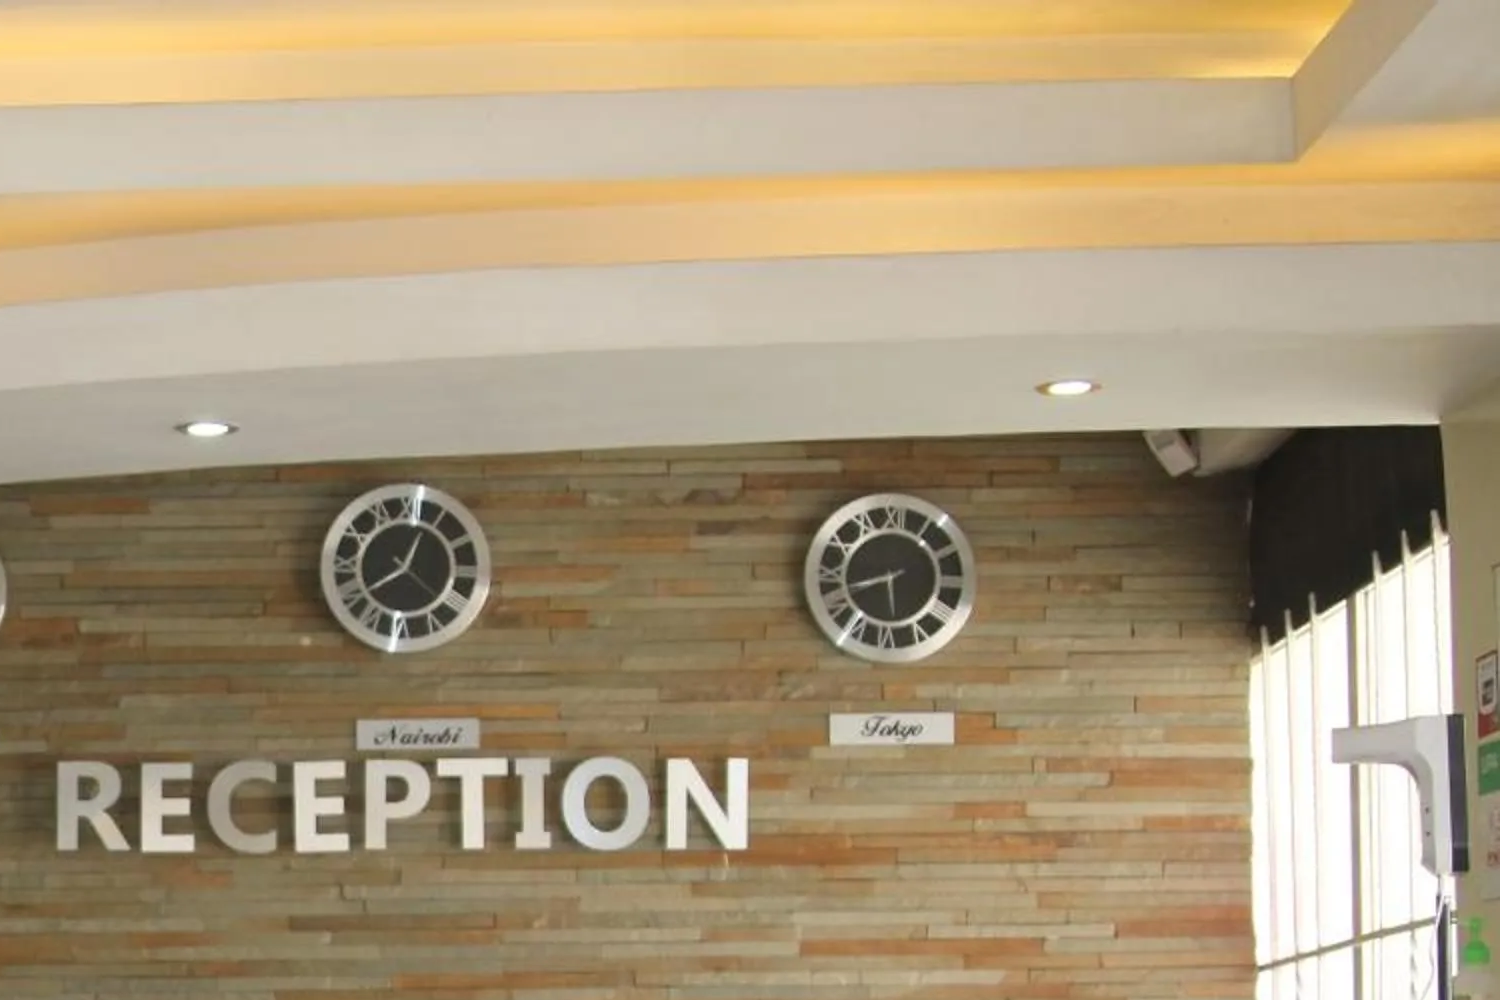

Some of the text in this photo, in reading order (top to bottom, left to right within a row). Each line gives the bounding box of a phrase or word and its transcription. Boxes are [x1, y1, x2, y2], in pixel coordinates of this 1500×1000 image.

[373, 724, 463, 745] Nairobi
[860, 715, 924, 742] Tokyo
[56, 756, 749, 854] RECEPTION
